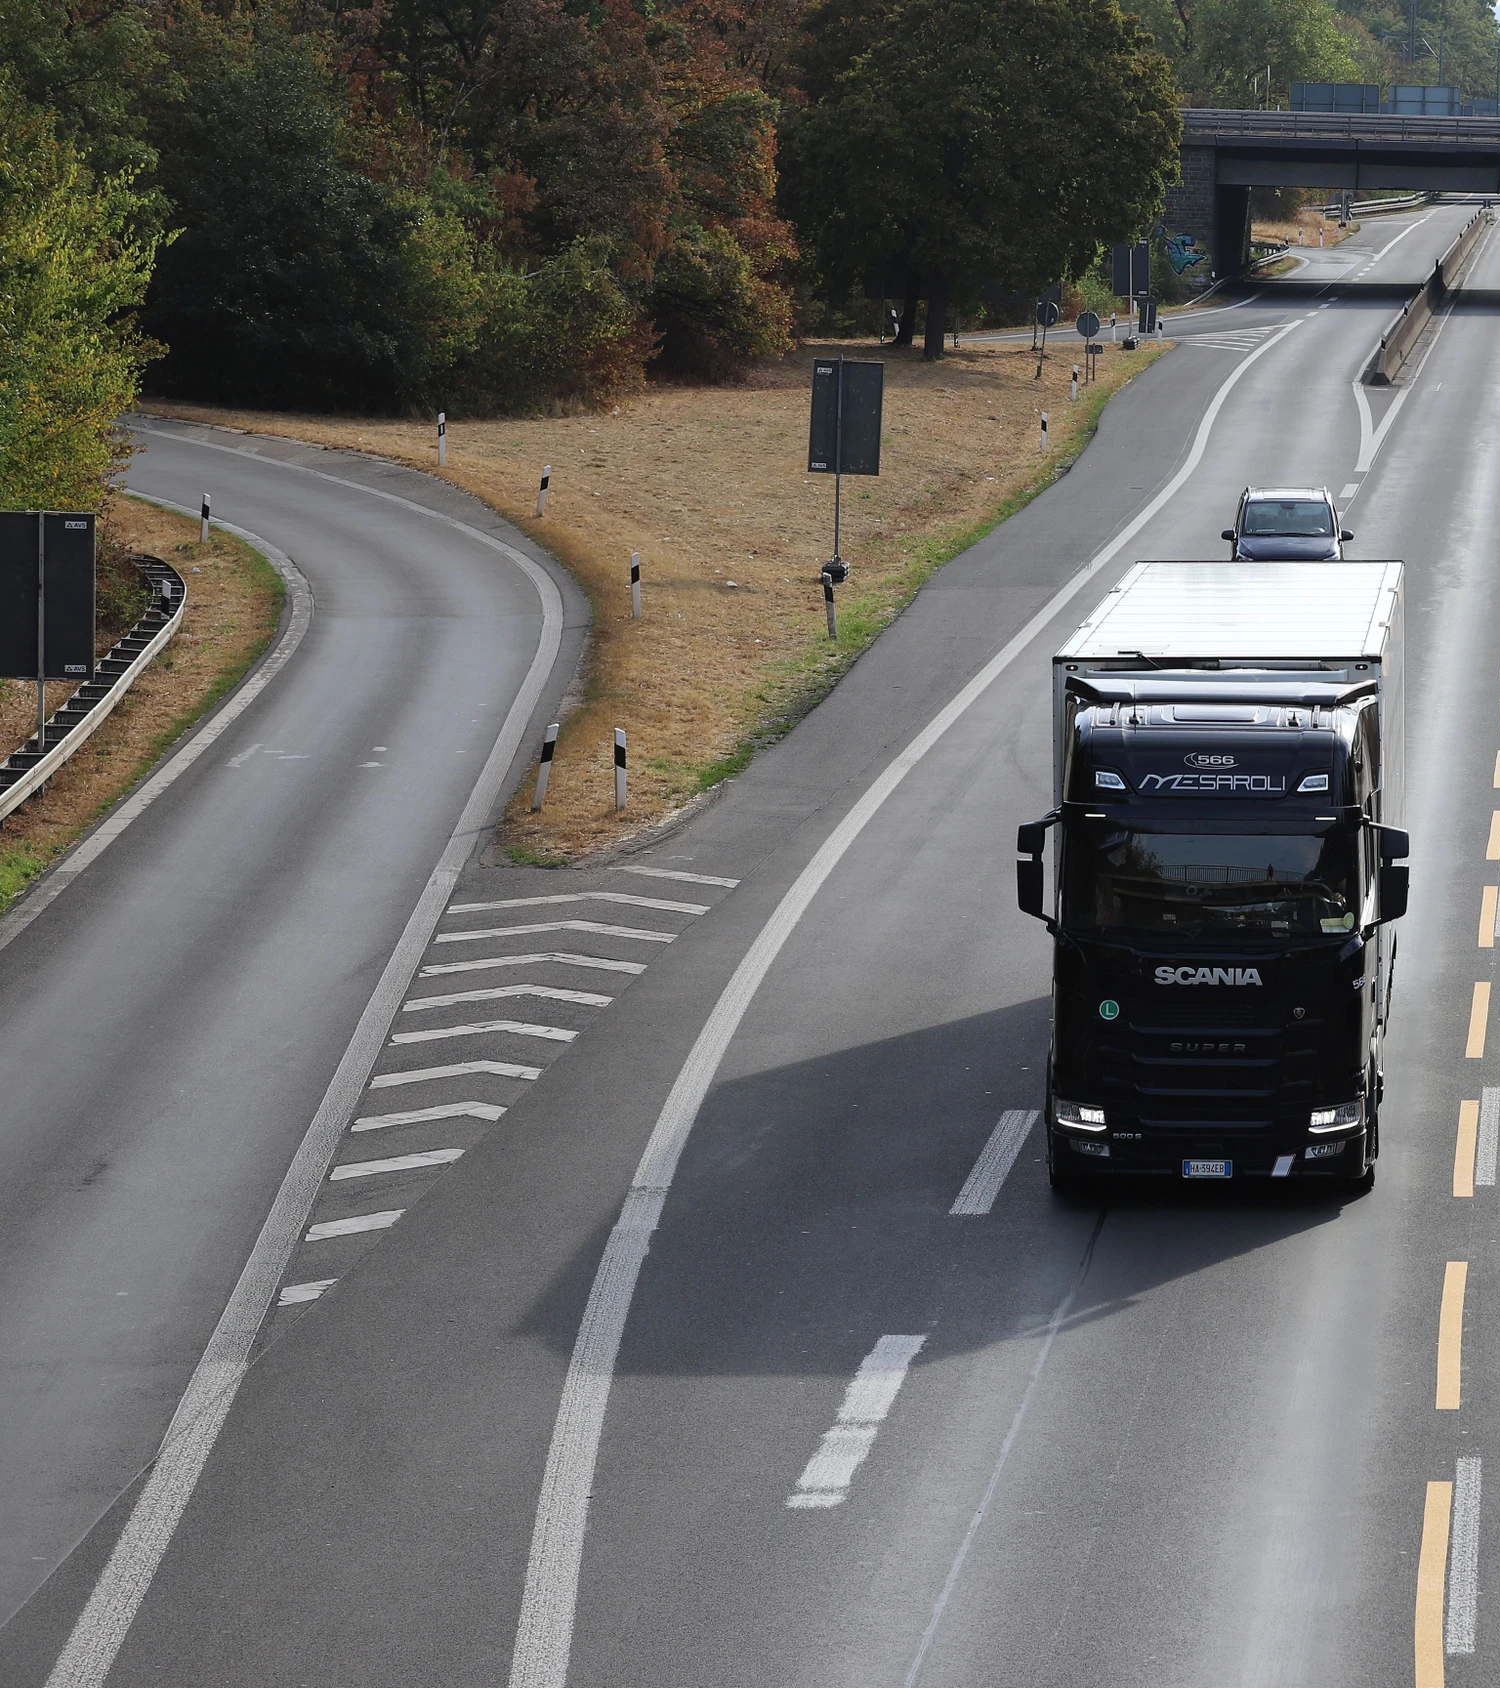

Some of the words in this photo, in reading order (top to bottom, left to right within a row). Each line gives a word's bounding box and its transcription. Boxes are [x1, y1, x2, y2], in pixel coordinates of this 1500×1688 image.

[1197, 755, 1235, 765] 566
[1138, 774, 1286, 791] MESAROLI
[1154, 966, 1263, 986] SCANIA
[1105, 1003, 1114, 1016] L
[1170, 1042, 1246, 1052] SUPER
